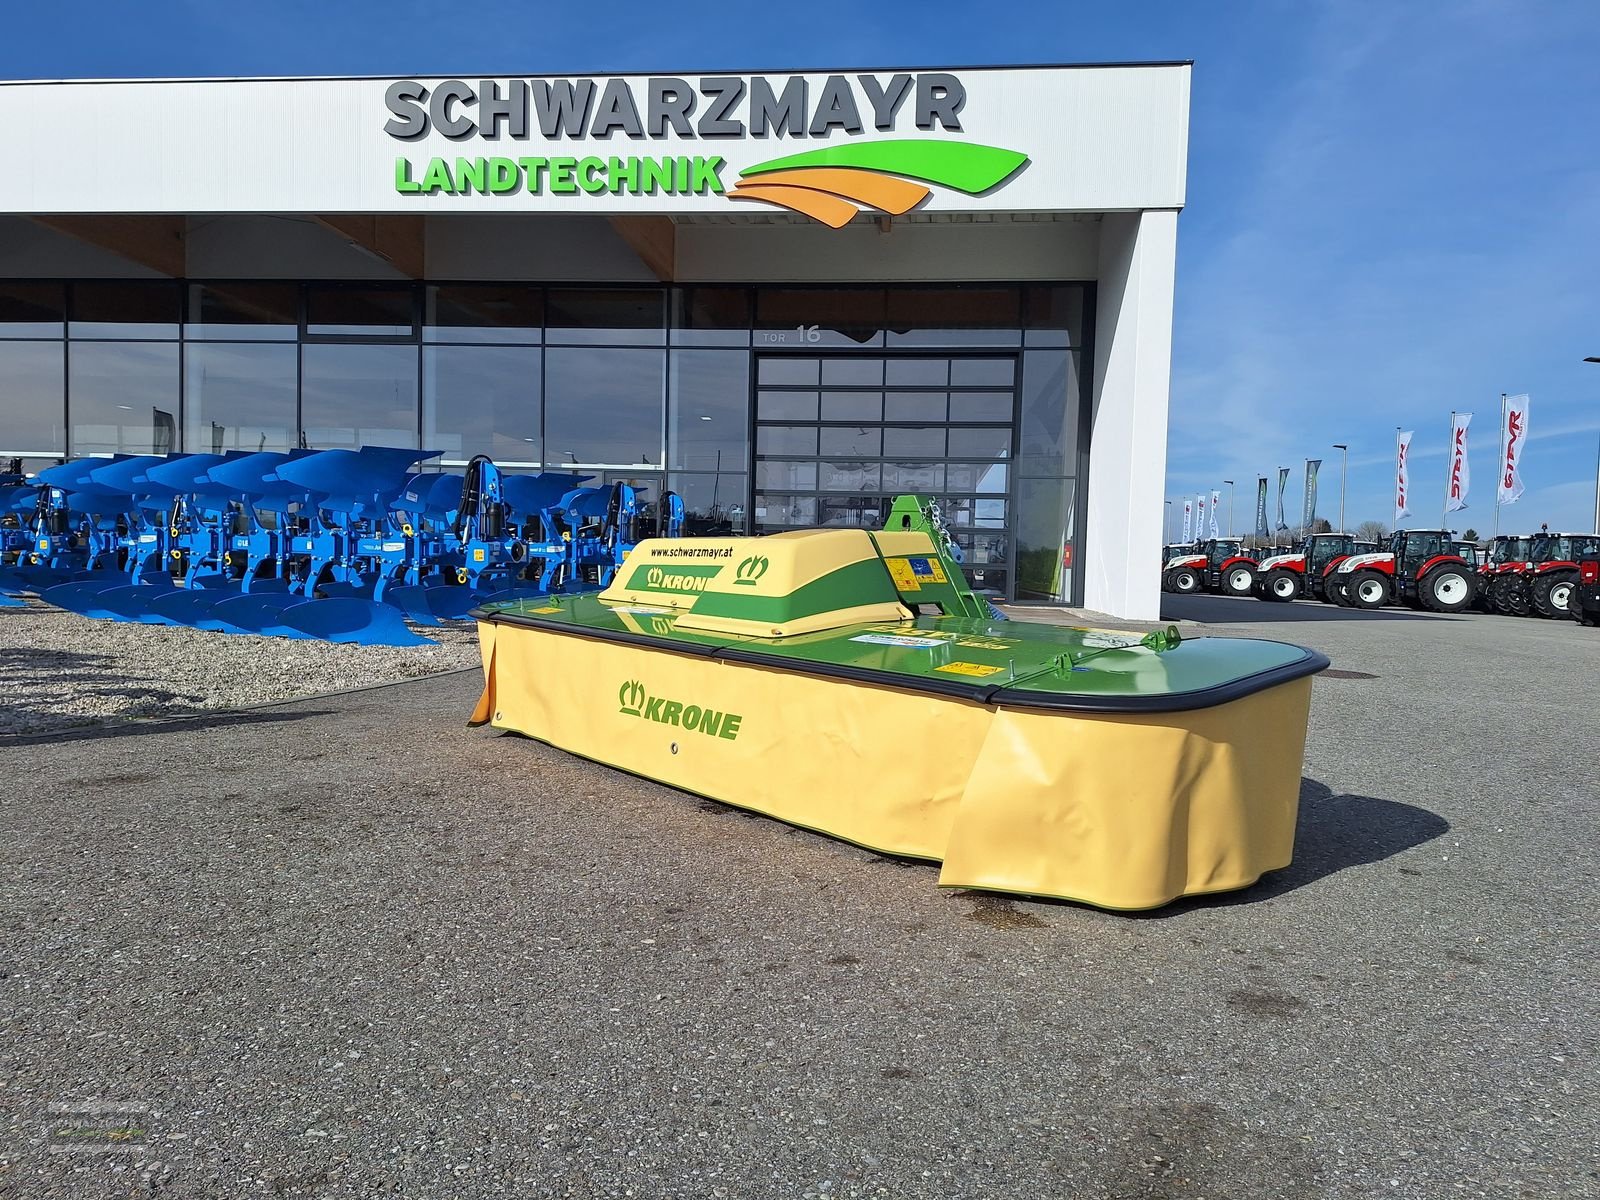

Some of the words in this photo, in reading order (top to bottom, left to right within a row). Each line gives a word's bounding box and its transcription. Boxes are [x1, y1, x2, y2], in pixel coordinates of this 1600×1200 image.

[384, 73, 965, 140] SCHWARZMAYR
[394, 155, 726, 196] LANDTECHNIK
[763, 333, 786, 343] TOR
[797, 324, 821, 343] 16
[651, 546, 734, 560] www.schwarzmayr.at
[661, 574, 708, 592] KRON
[644, 696, 743, 741] KRONE
